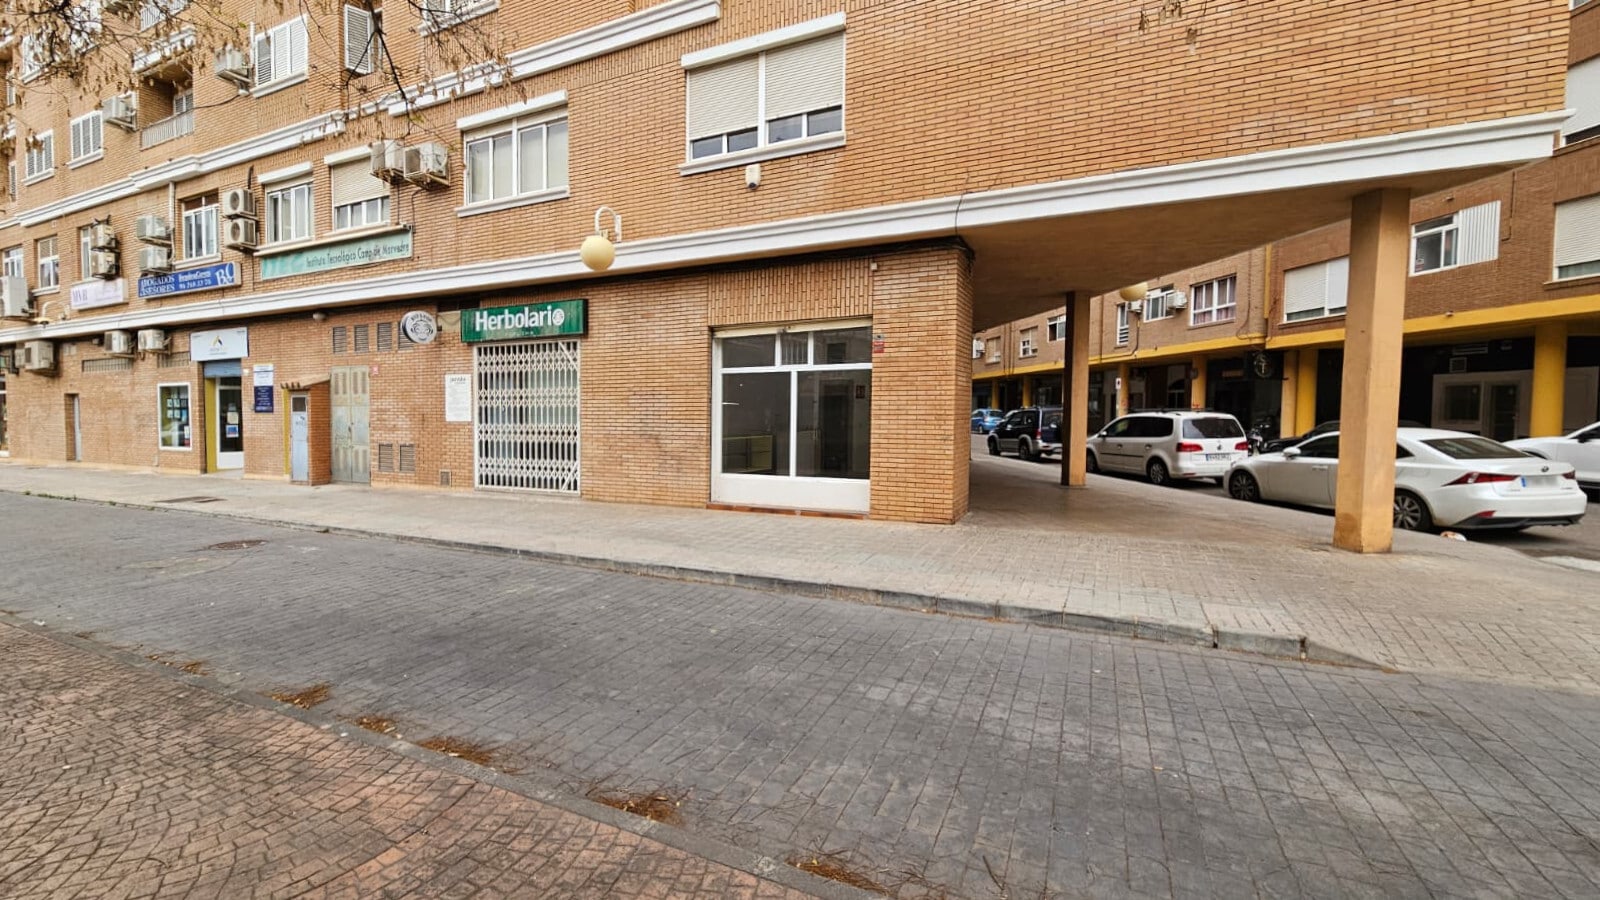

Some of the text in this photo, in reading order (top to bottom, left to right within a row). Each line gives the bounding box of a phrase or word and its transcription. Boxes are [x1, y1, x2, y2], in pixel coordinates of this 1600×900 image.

[141, 274, 175, 288] ABOGADOS
[140, 283, 176, 297] ASESORES
[475, 305, 565, 332] Herbolario
